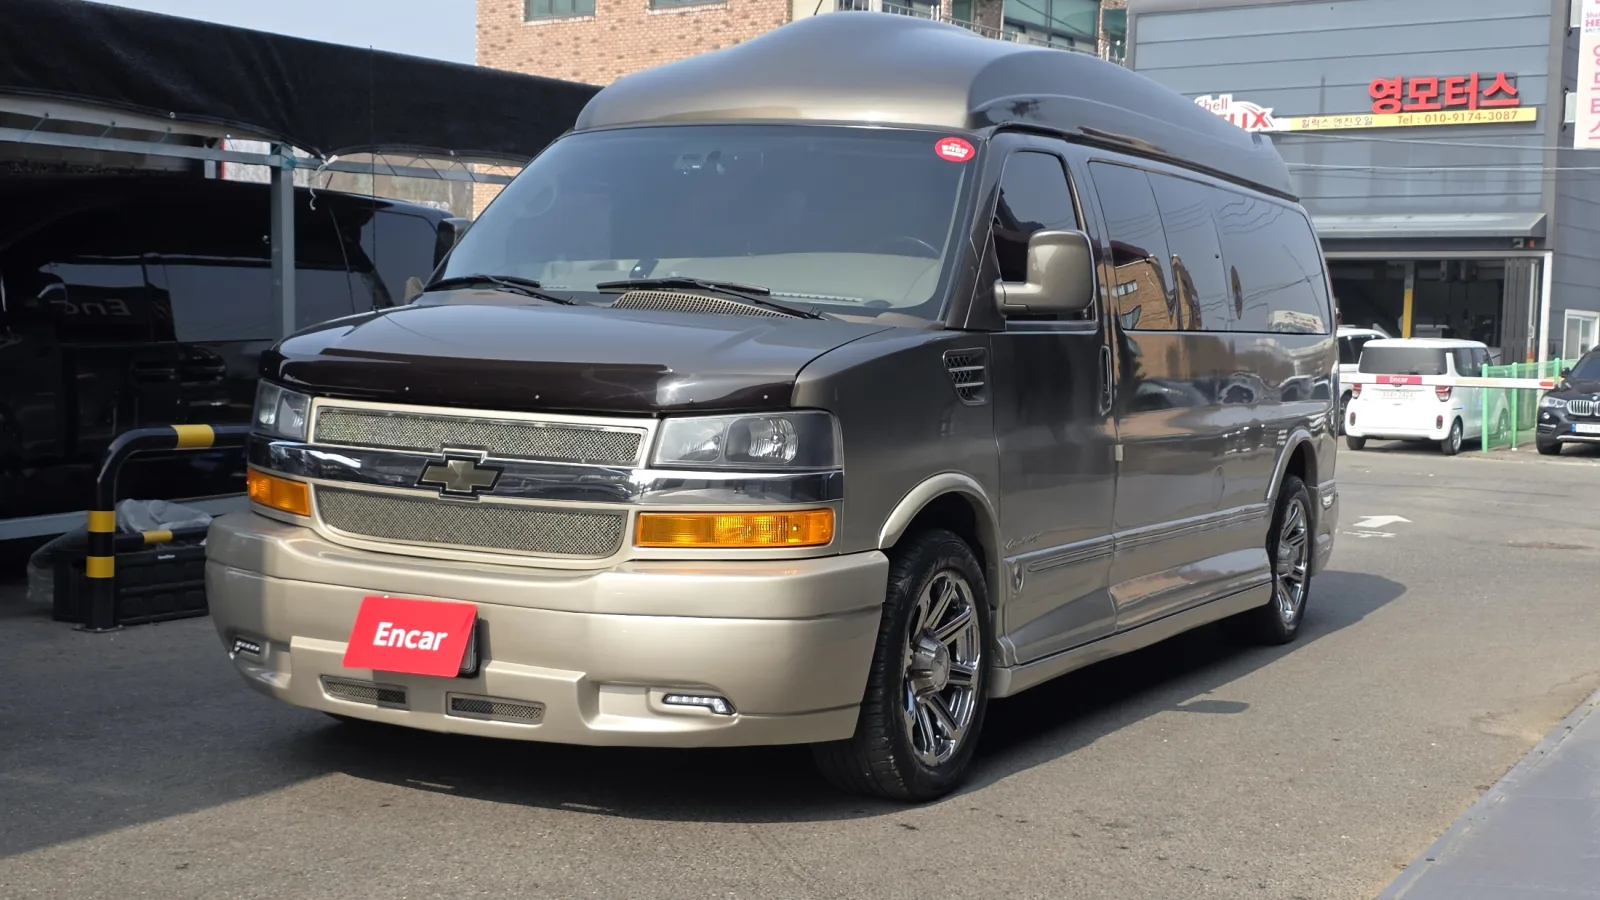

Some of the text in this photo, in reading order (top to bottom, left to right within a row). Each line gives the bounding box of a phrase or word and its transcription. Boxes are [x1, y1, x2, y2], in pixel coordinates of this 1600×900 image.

[1368, 71, 1520, 114] 영모터스
[1397, 114, 1413, 124] Tel
[1424, 110, 1518, 124] 010-9174-3087
[372, 621, 448, 651] Encar
